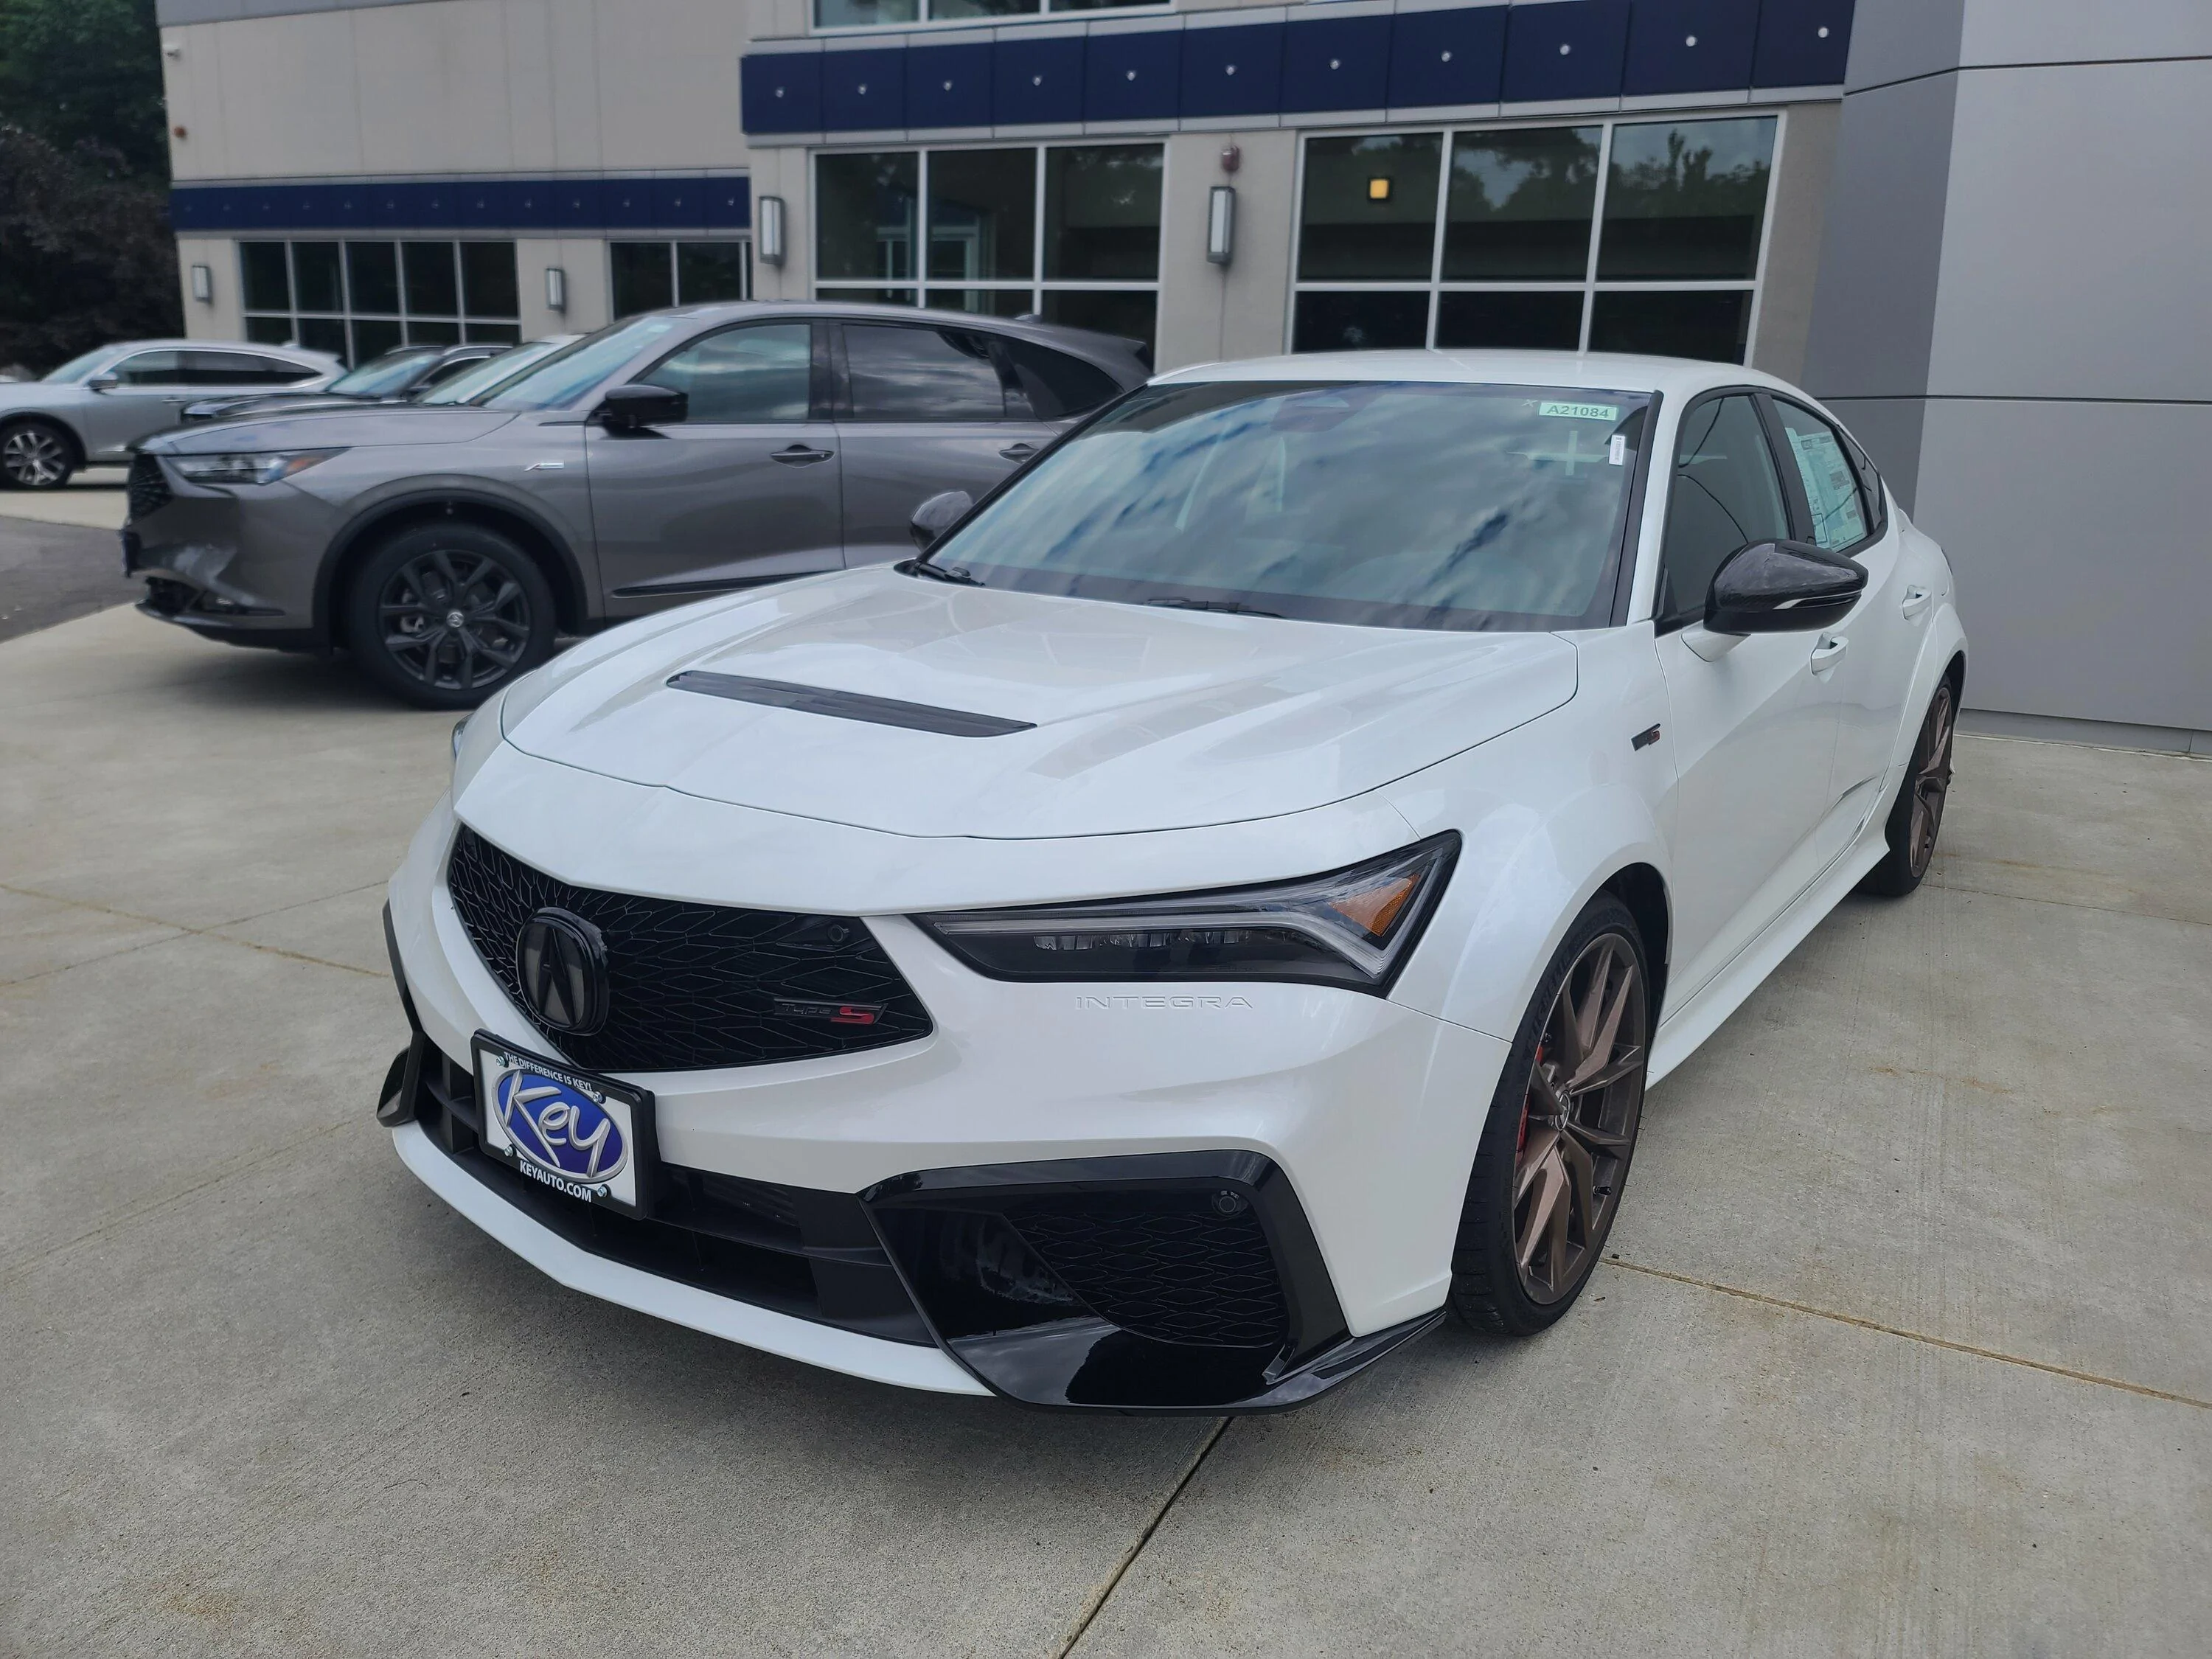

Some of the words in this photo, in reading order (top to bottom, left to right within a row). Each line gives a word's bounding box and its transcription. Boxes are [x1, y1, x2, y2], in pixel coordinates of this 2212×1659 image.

[1547, 405, 1609, 418] A21084
[830, 1005, 875, 1025] S
[1075, 996, 1253, 1009] INTEGRA
[504, 1051, 518, 1065] THE
[518, 1058, 563, 1082] DIFFERENCE
[564, 1074, 572, 1085] IS
[572, 1077, 592, 1091] KEY!
[504, 1069, 611, 1178] Key
[519, 1159, 592, 1203] KEYAUTO.COM
